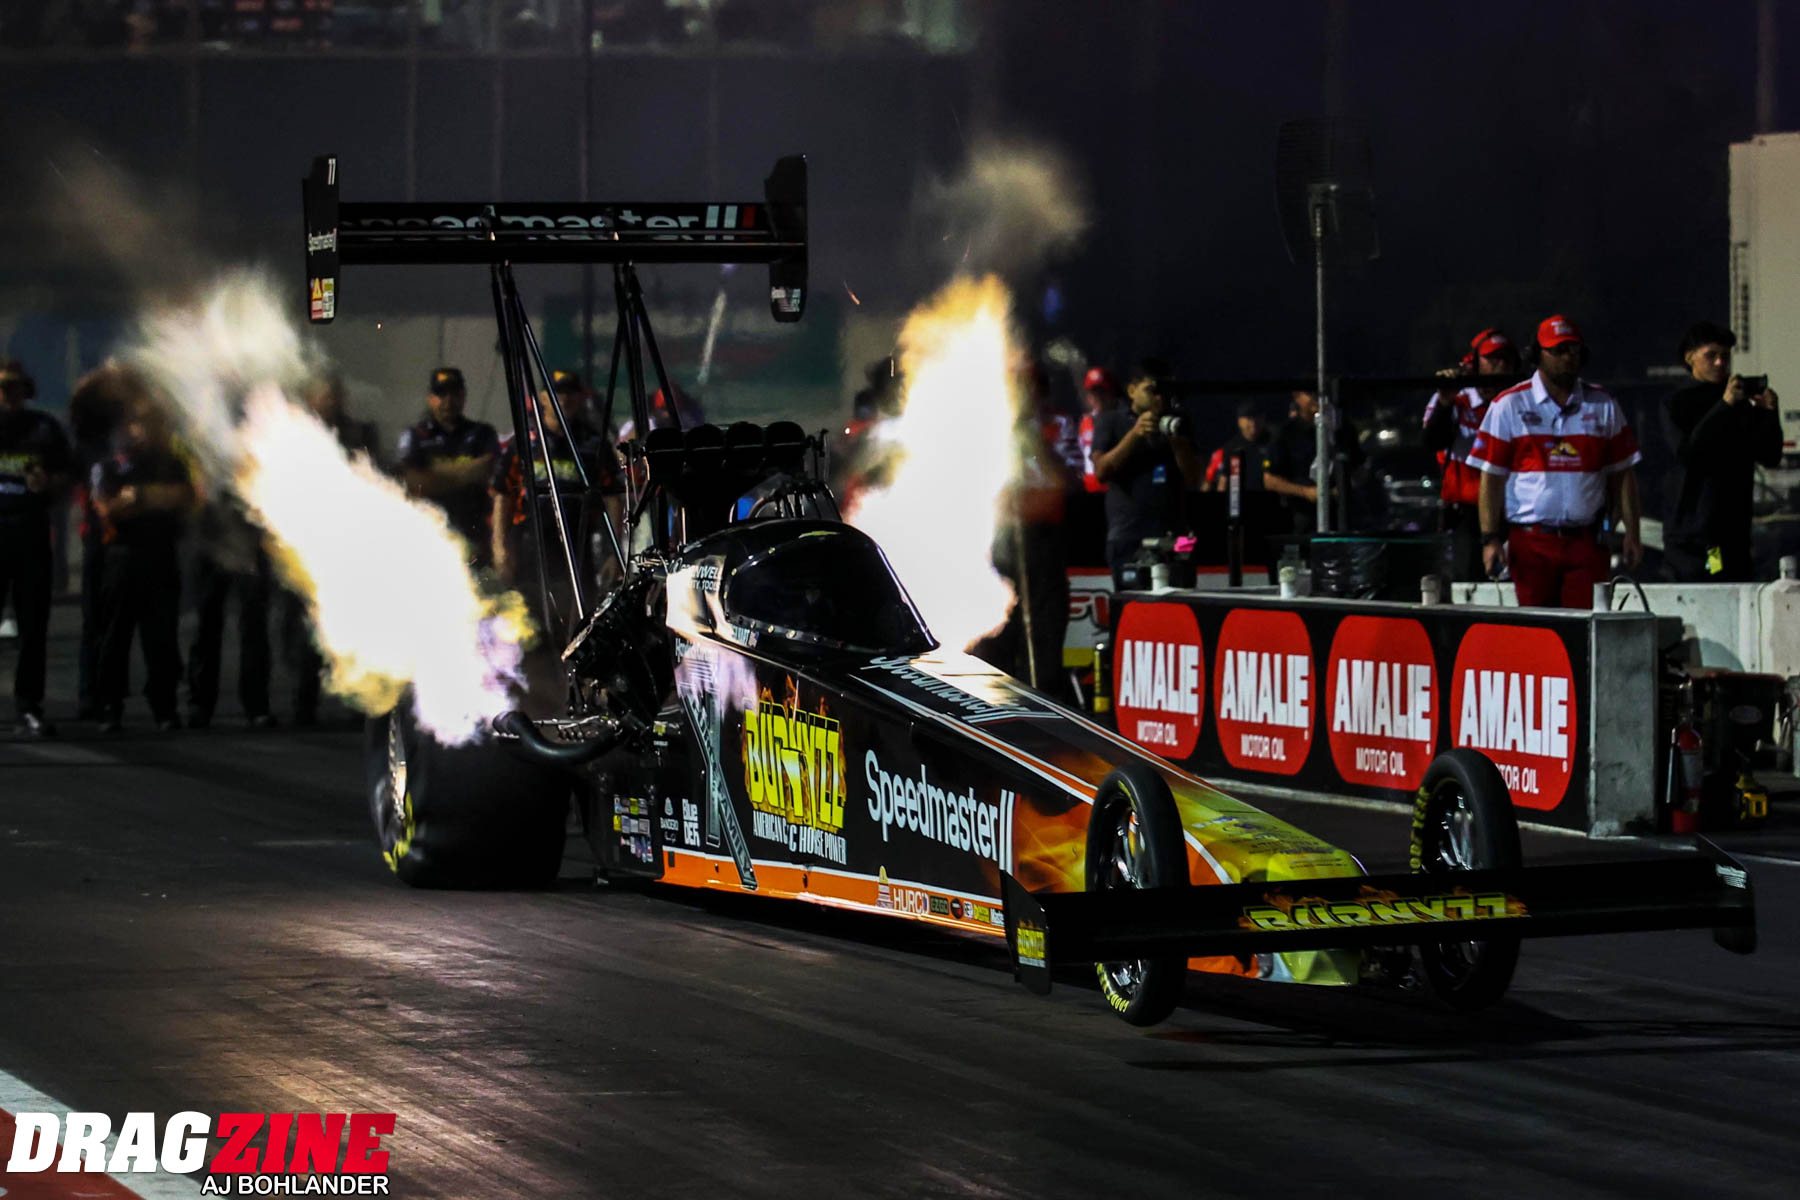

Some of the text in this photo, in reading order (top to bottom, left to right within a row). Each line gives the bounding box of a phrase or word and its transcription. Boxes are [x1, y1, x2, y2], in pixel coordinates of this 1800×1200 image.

[1119, 639, 1199, 716] AMALIE
[1220, 649, 1310, 729] AMALIE
[1333, 658, 1432, 743] AMALIE
[1459, 669, 1569, 760] AMALIE
[1137, 719, 1179, 747] MOTOR OIL
[1240, 733, 1287, 762] MOTOR OIL
[1355, 747, 1407, 777] MOTOR OIL
[865, 749, 998, 861] Speedmaster
[1495, 763, 1540, 795] TOR OIL
